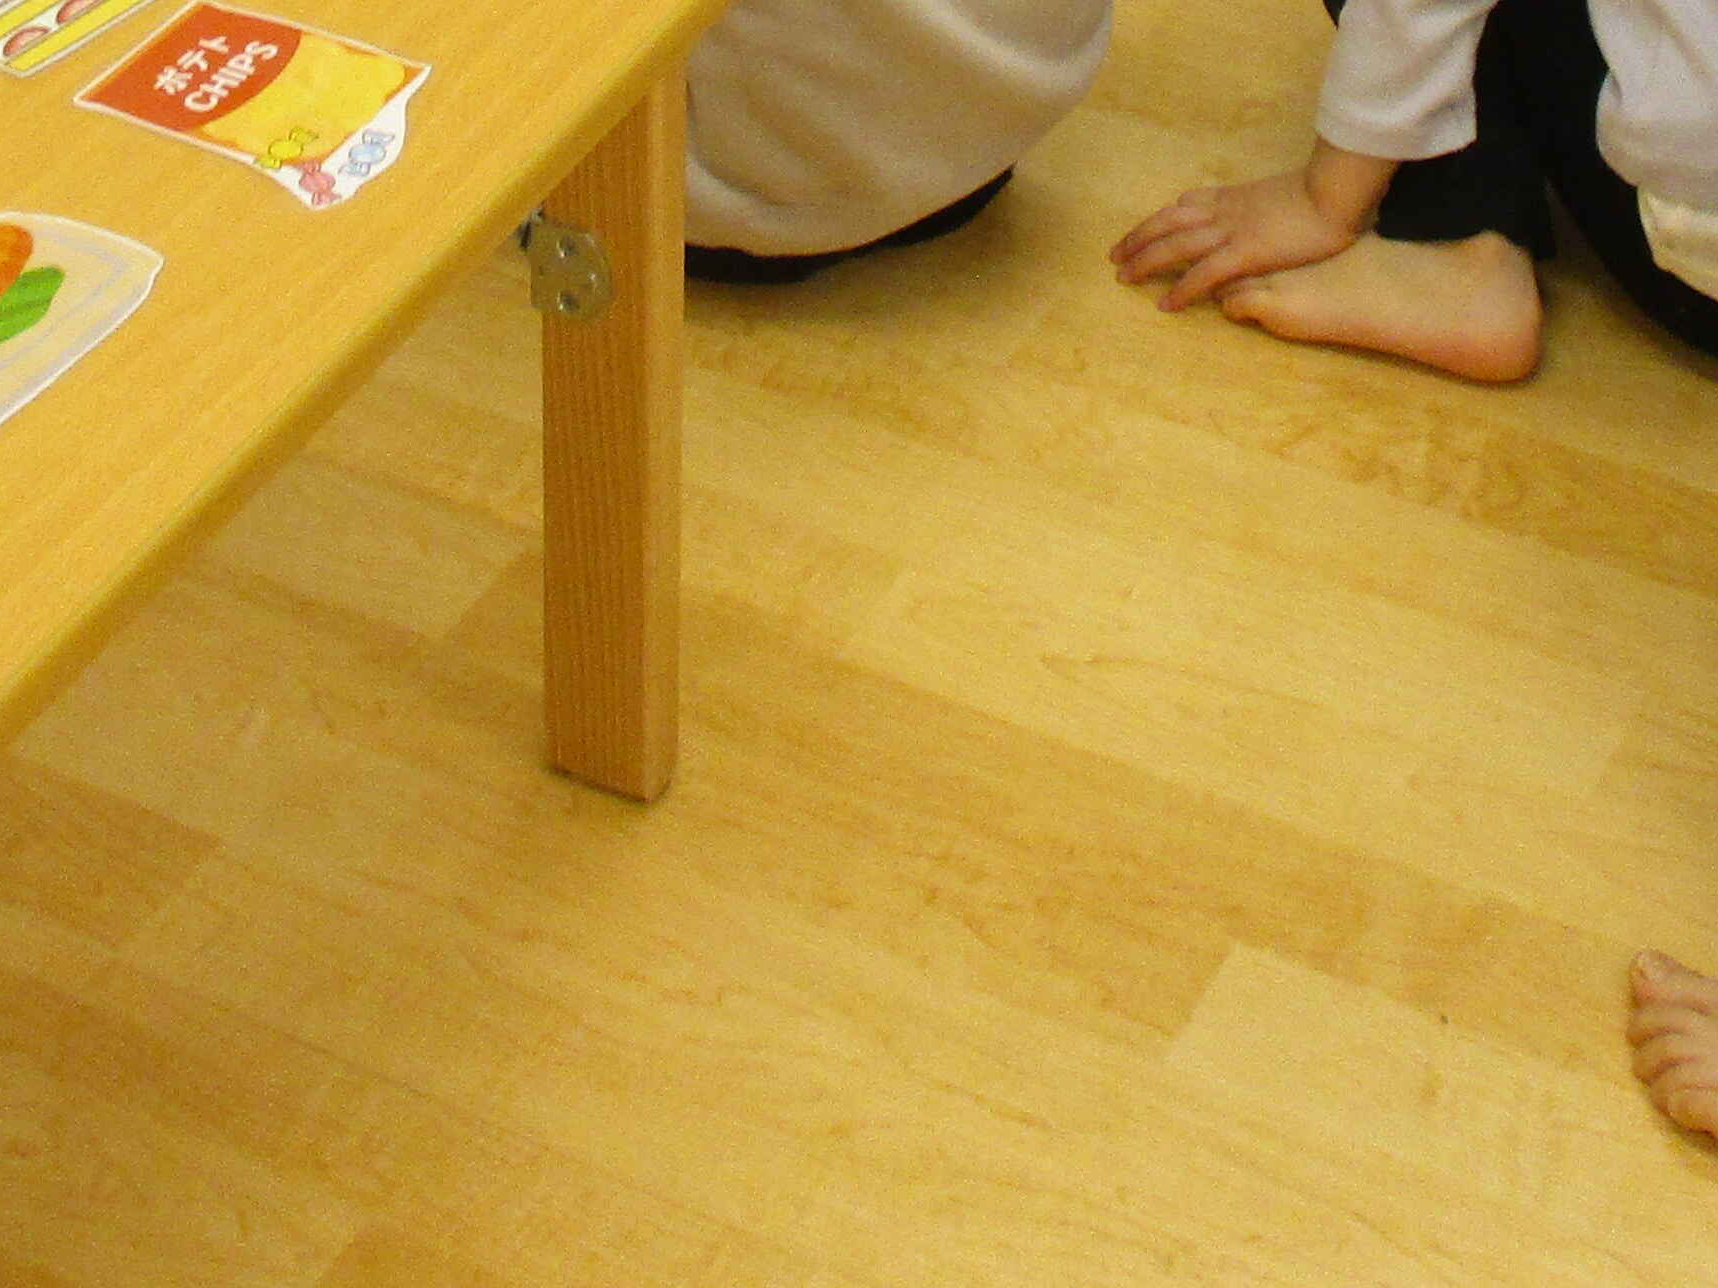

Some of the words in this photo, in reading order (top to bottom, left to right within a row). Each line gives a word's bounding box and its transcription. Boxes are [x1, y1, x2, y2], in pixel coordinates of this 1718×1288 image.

[155, 35, 231, 95] ポテト
[183, 40, 279, 113] CHIPS
